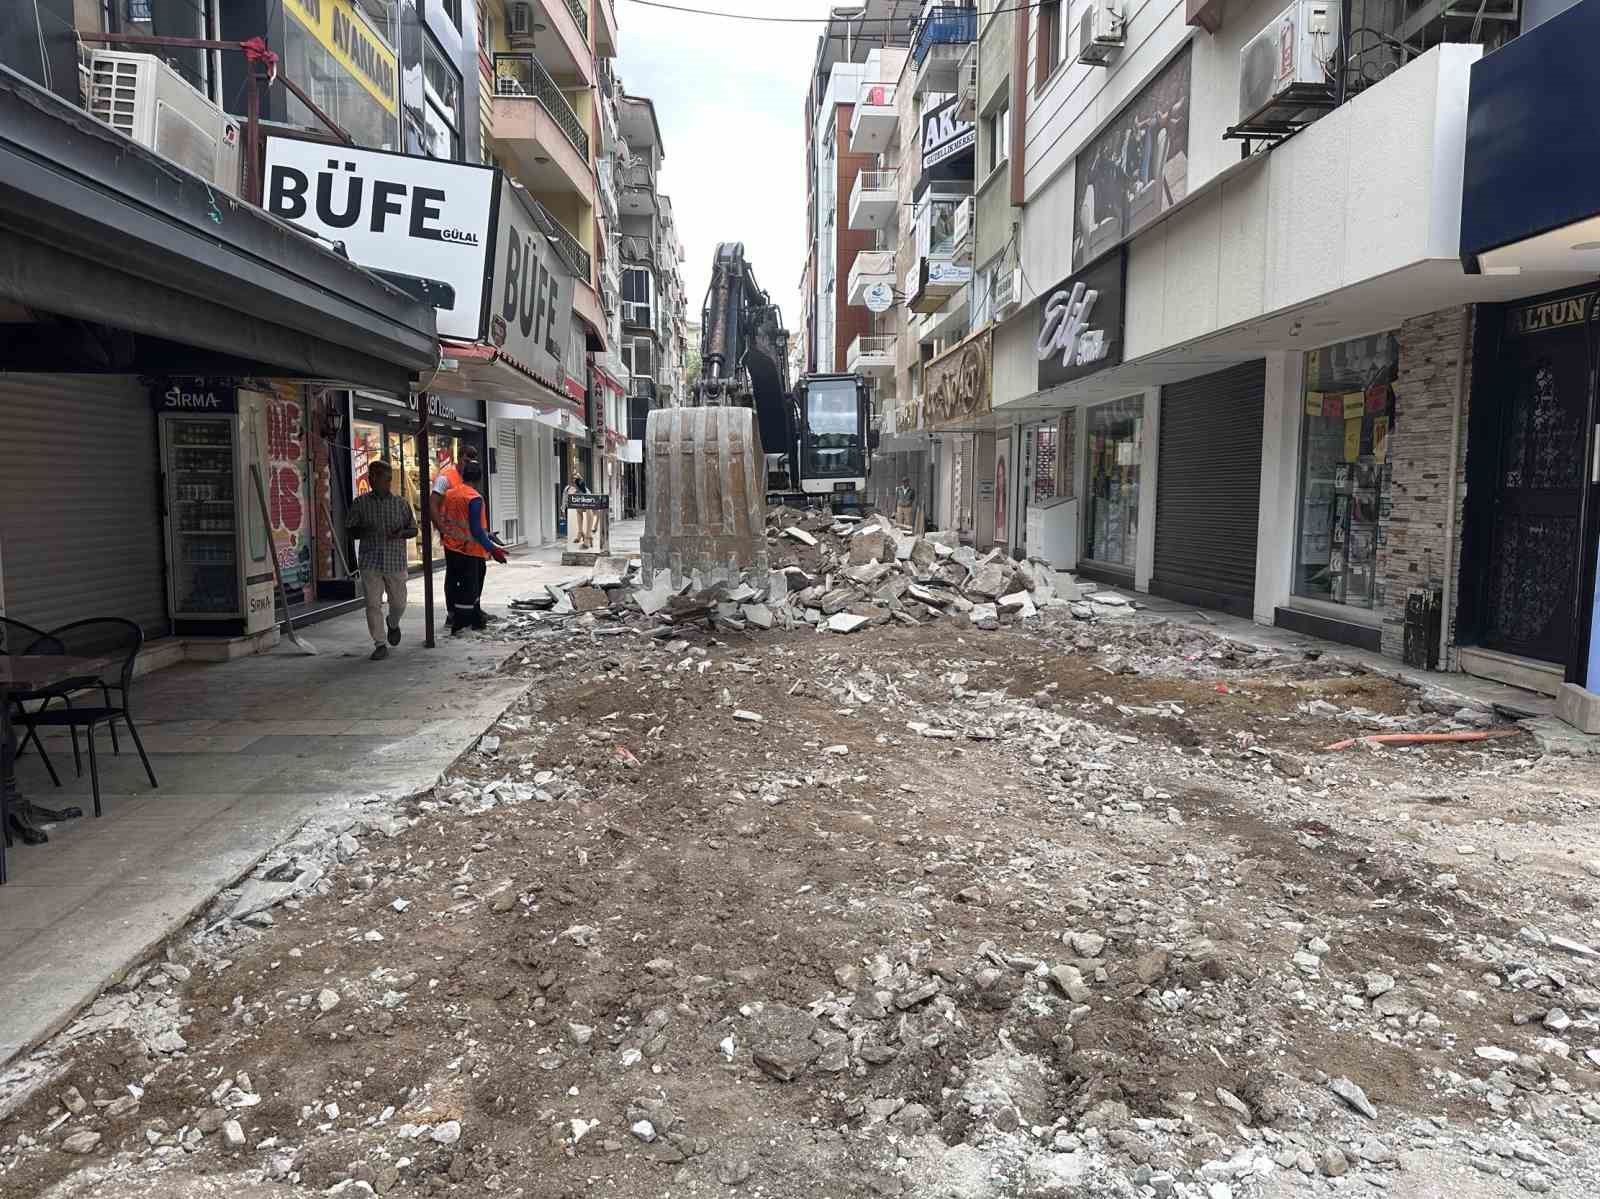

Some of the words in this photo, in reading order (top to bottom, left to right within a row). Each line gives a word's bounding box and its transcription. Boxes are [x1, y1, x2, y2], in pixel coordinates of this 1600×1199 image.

[332, 5, 395, 102] AYAKKABI
[269, 159, 446, 238] BÜFE
[442, 228, 479, 243] GÜLAL
[503, 225, 560, 360] BÜFE
